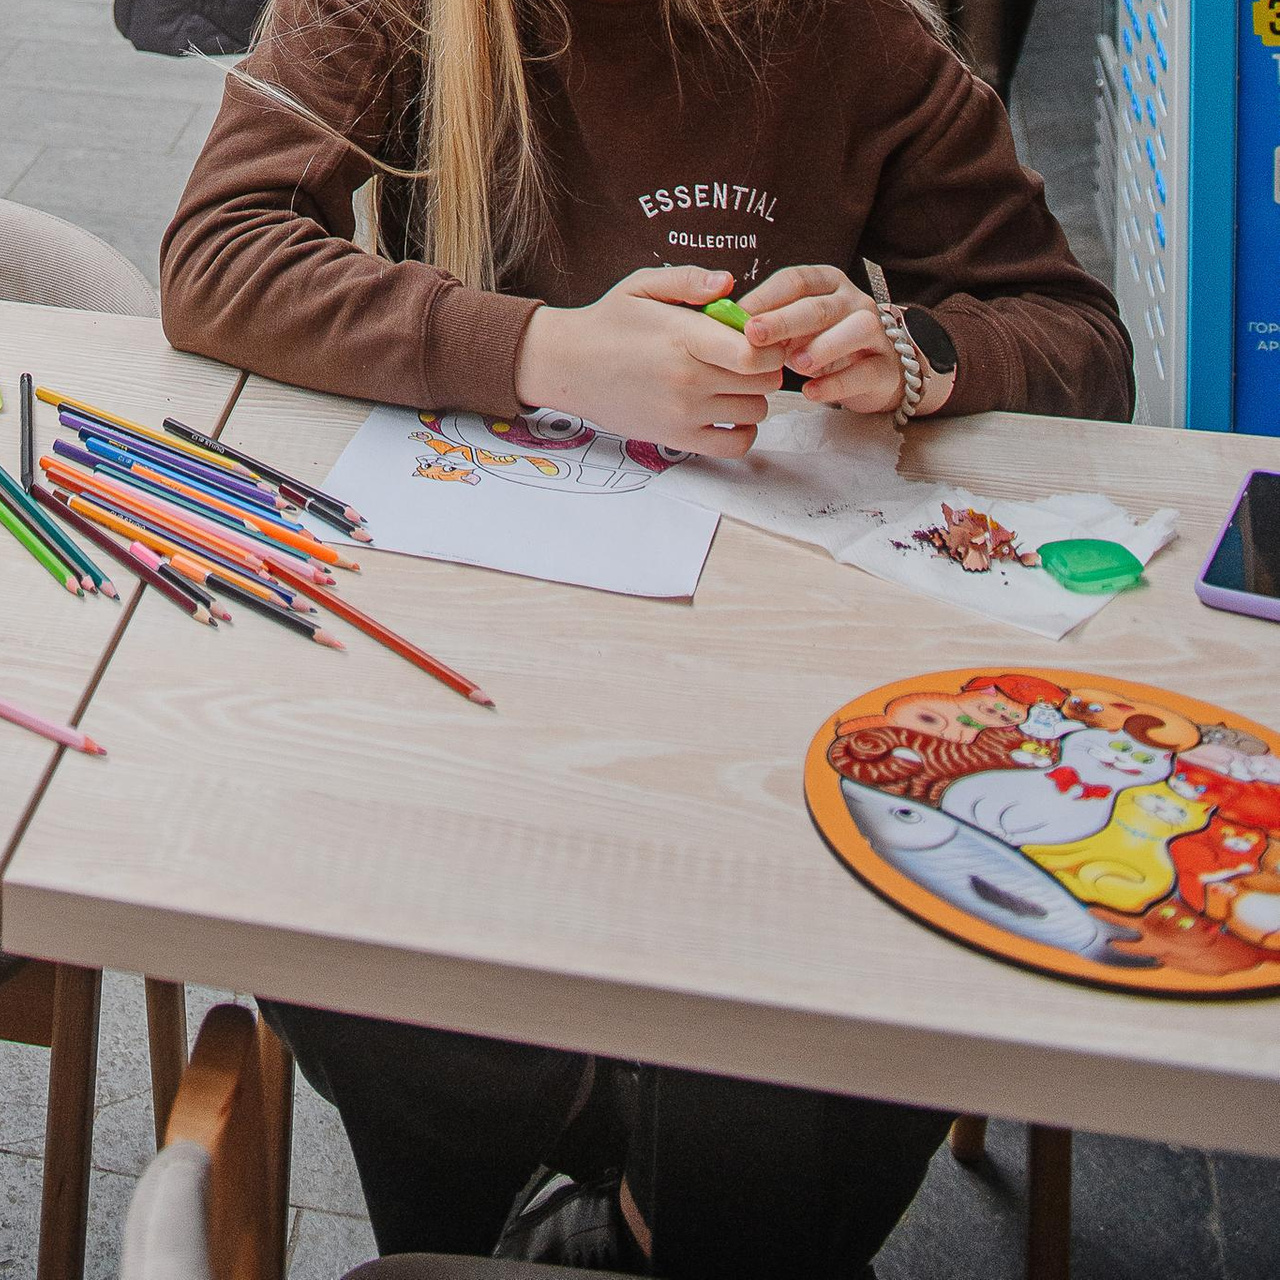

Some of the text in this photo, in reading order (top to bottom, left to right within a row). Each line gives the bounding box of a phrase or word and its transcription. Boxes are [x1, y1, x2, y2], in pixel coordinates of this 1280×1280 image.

[638, 182, 777, 222] ESSENTIAL
[668, 231, 757, 249] COLLECTION
[1249, 321, 1280, 334] ГОР
